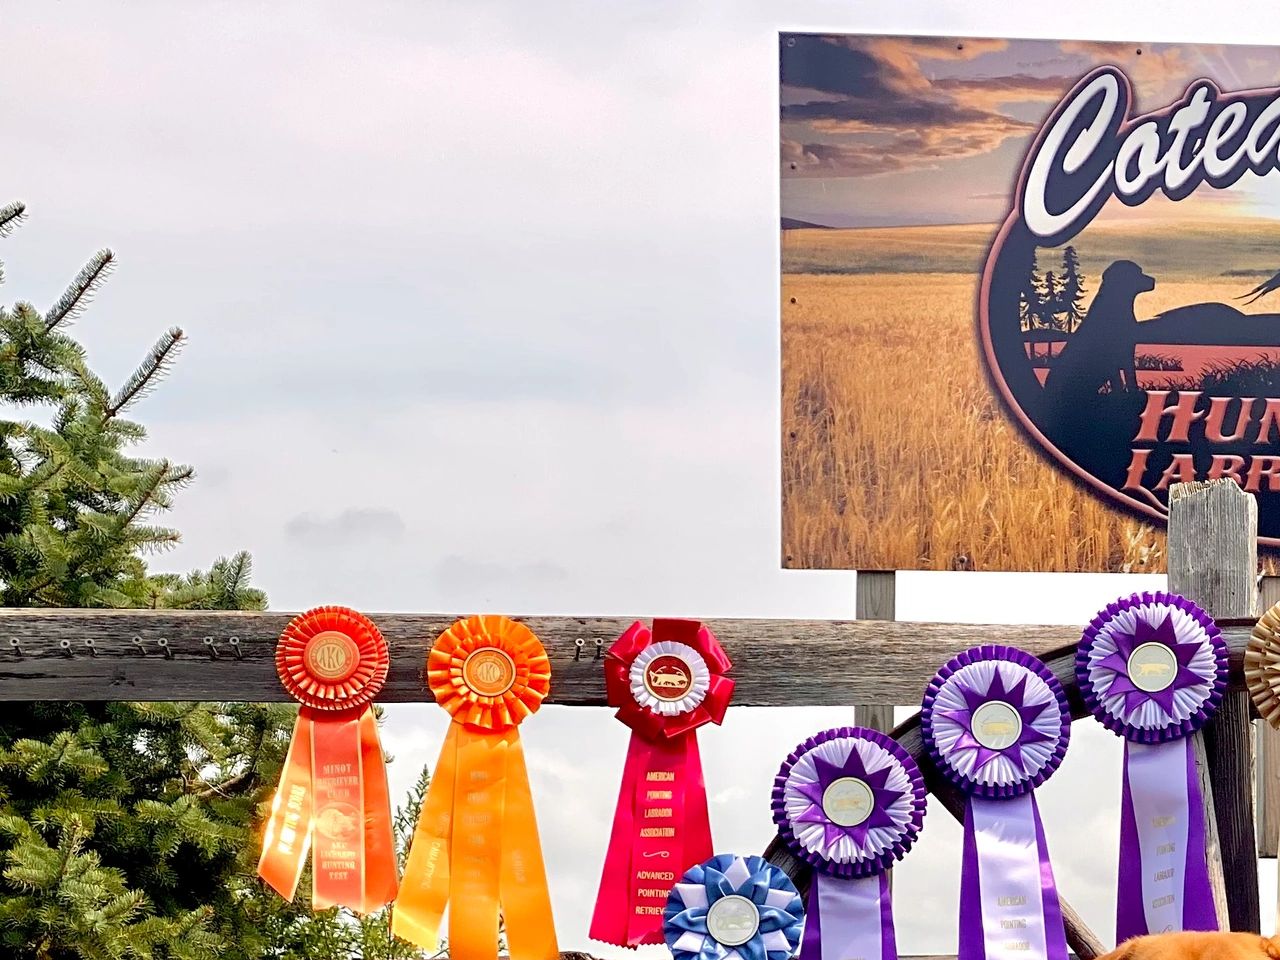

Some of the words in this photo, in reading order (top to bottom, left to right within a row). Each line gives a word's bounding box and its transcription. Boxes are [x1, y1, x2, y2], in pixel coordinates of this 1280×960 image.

[317, 645, 345, 669] AKC
[322, 763, 352, 775] MINOT
[646, 771, 675, 782] AMERICAN
[636, 870, 675, 881] ADVANCED
[635, 906, 665, 916] RETRIEV
